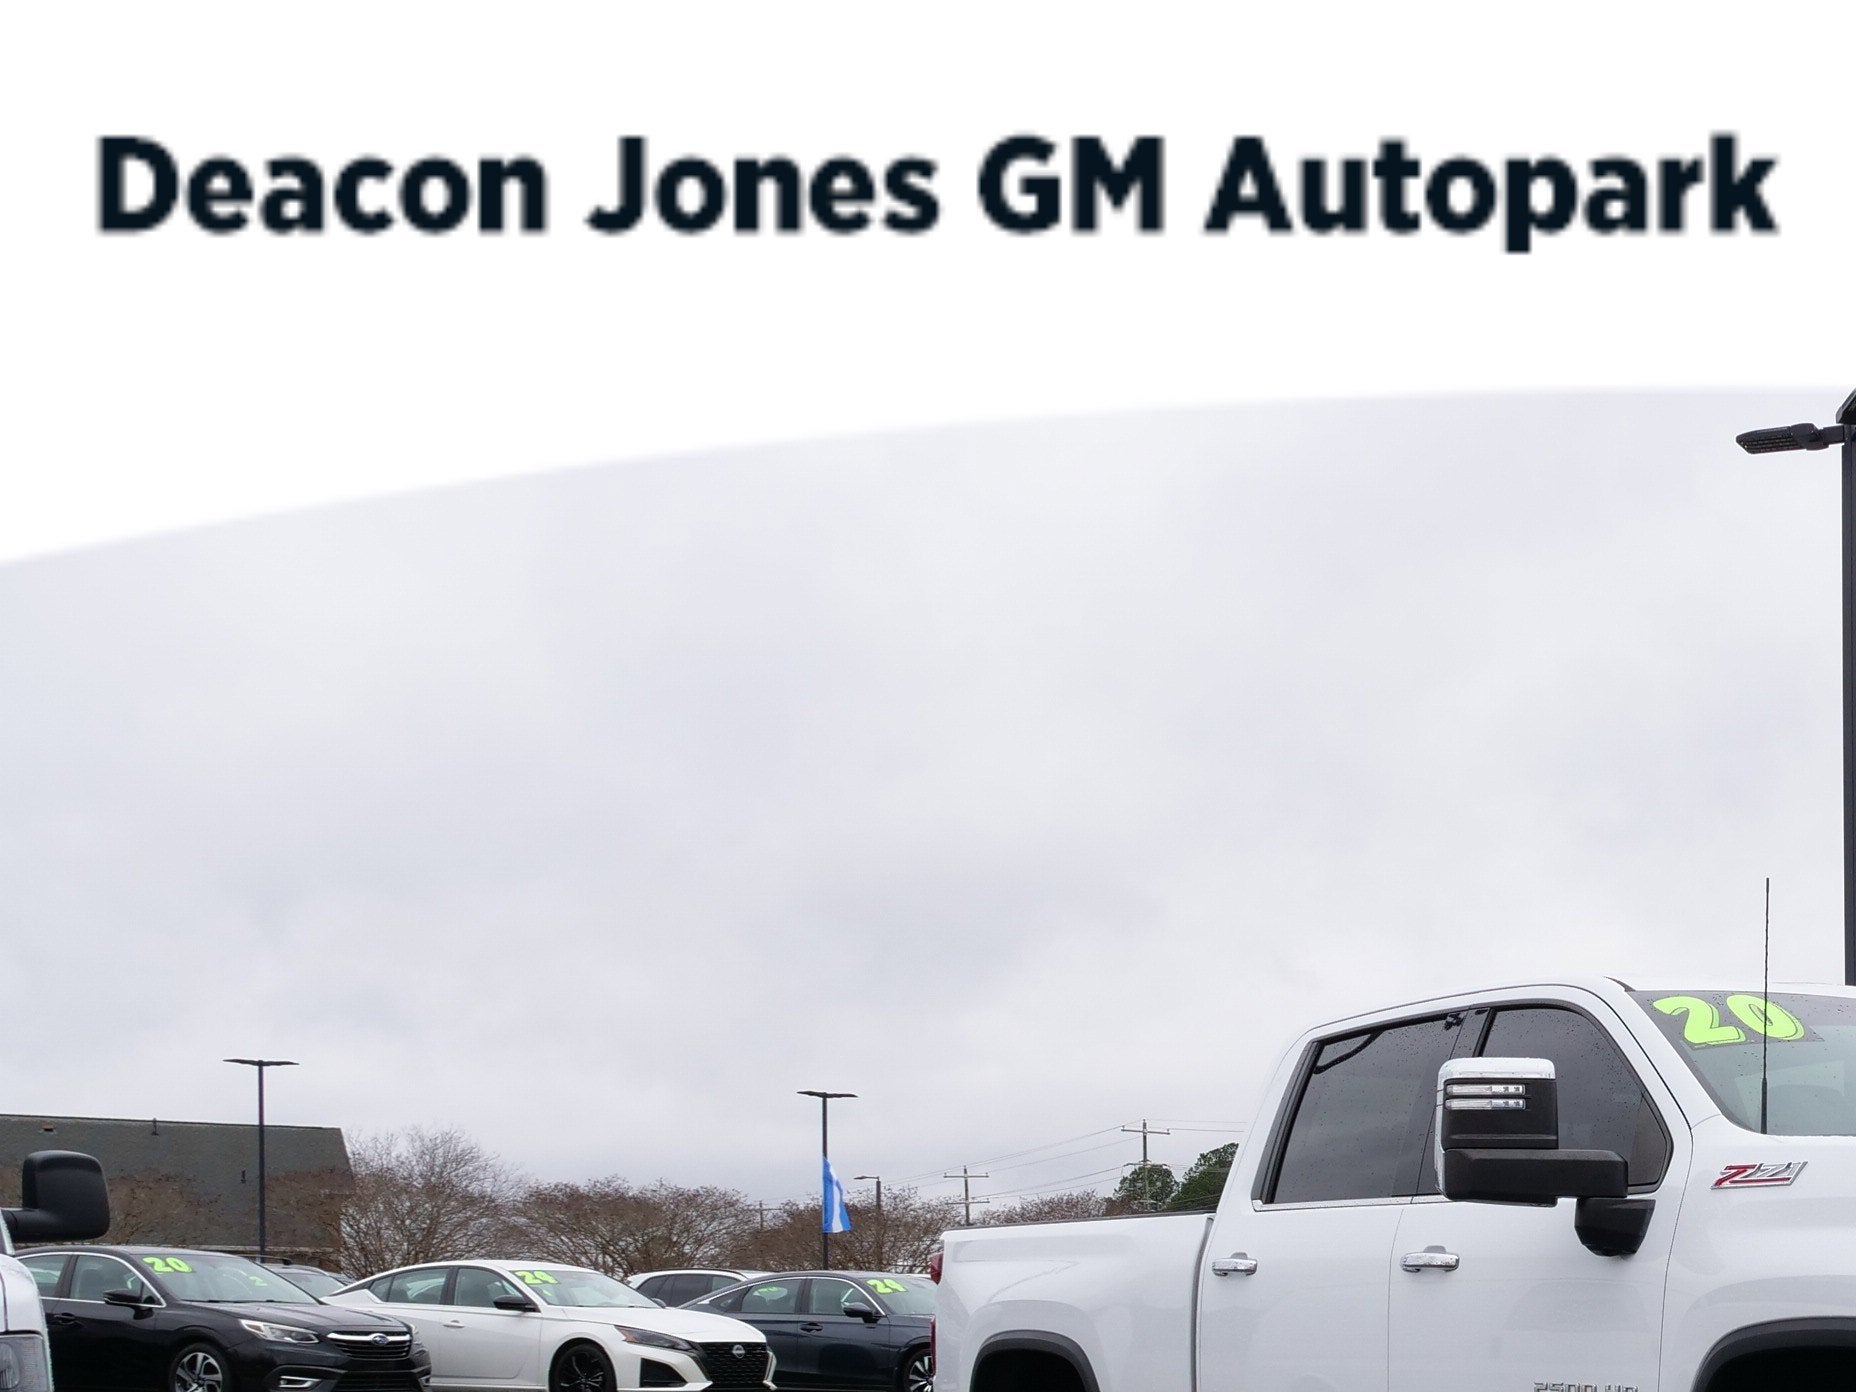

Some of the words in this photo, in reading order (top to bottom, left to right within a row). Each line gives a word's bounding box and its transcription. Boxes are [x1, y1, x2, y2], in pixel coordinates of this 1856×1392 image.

[1652, 993, 1805, 1045] 20
[1710, 1161, 1808, 1190] Z71
[142, 1256, 193, 1273] 20
[514, 1270, 559, 1285] 24
[866, 1278, 908, 1295] 24
